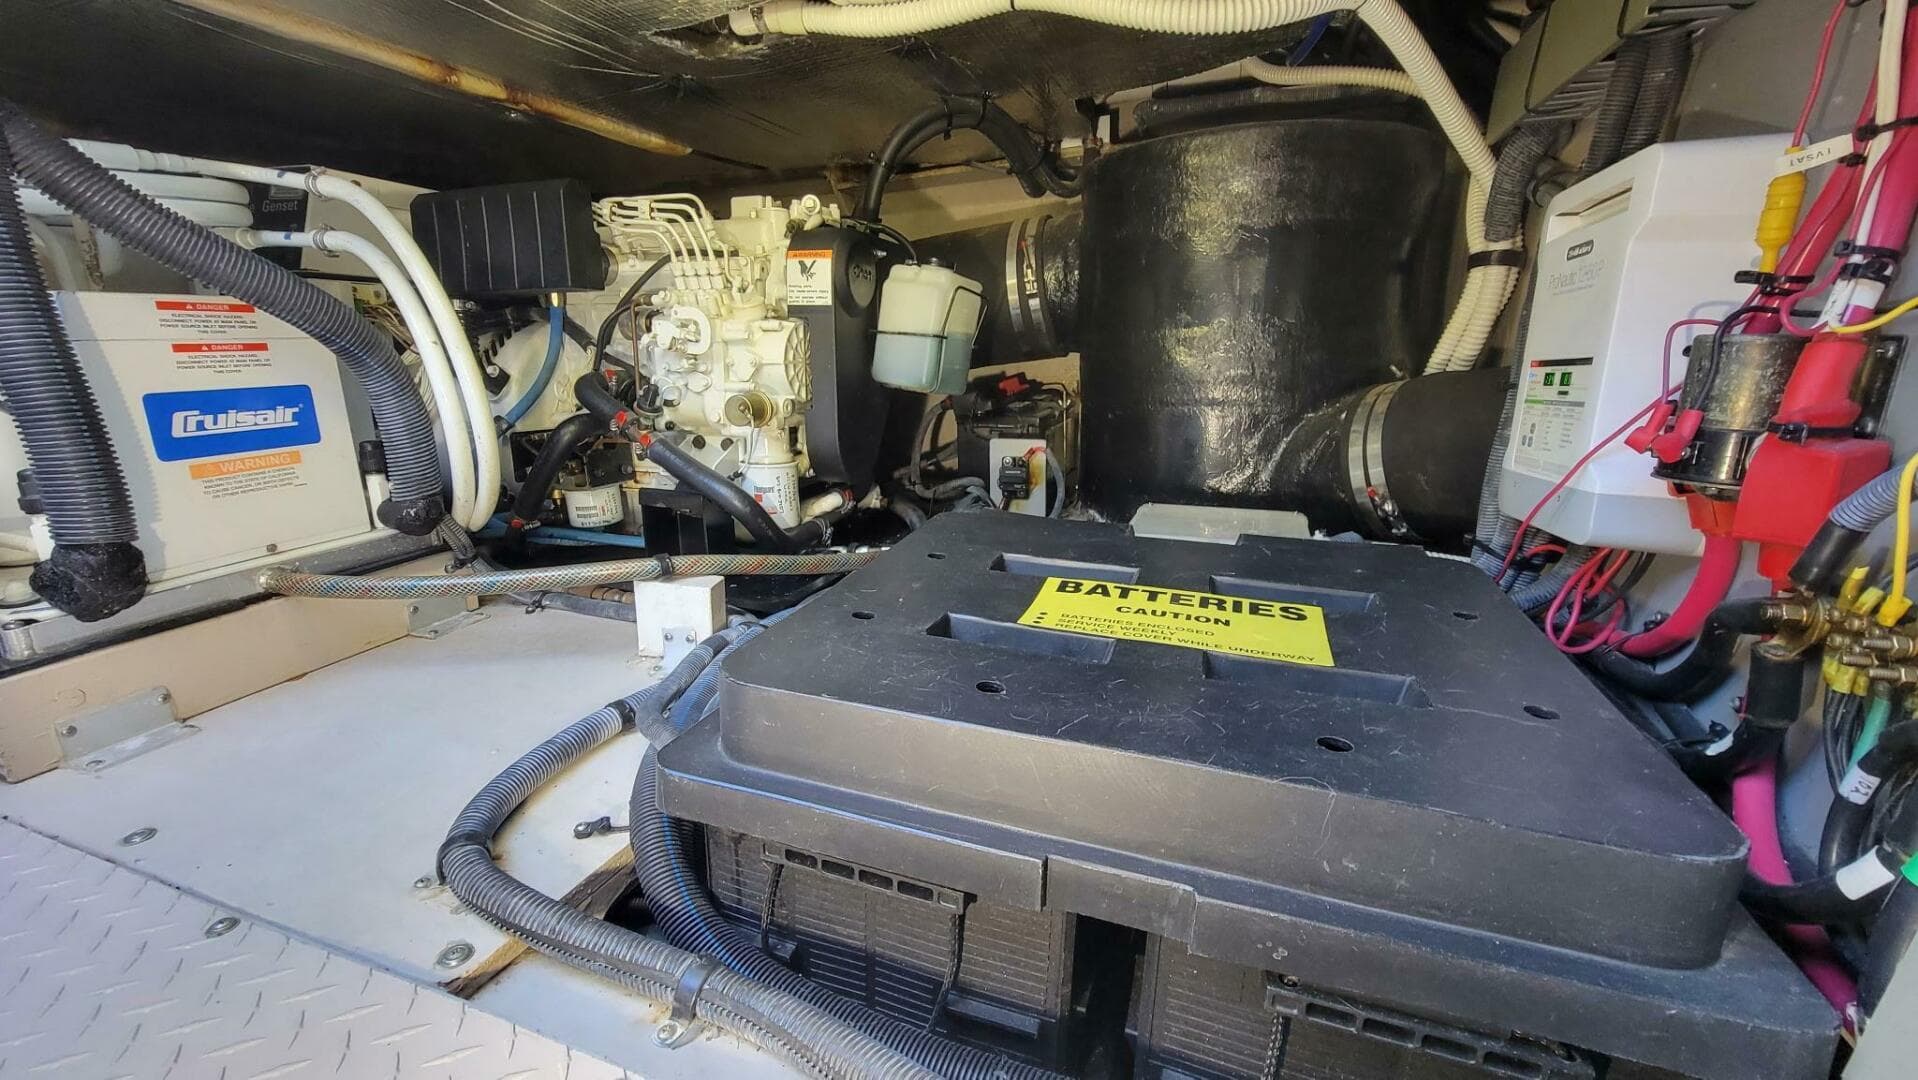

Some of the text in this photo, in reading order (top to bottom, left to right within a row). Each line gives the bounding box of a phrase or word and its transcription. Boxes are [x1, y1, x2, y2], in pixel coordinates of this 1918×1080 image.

[262, 200, 298, 212] Genset
[171, 406, 300, 438] Cruisair
[220, 453, 291, 473] WARNING
[1055, 580, 1308, 621] BATTERIES
[1058, 618, 1178, 637] SERVICE WEEKLY
[1059, 613, 1215, 637] BATTERIES ENCLOSED
[1116, 606, 1231, 627] CAUTION
[1054, 622, 1316, 663] REPLACE COVER WHILE UNDERWAY
